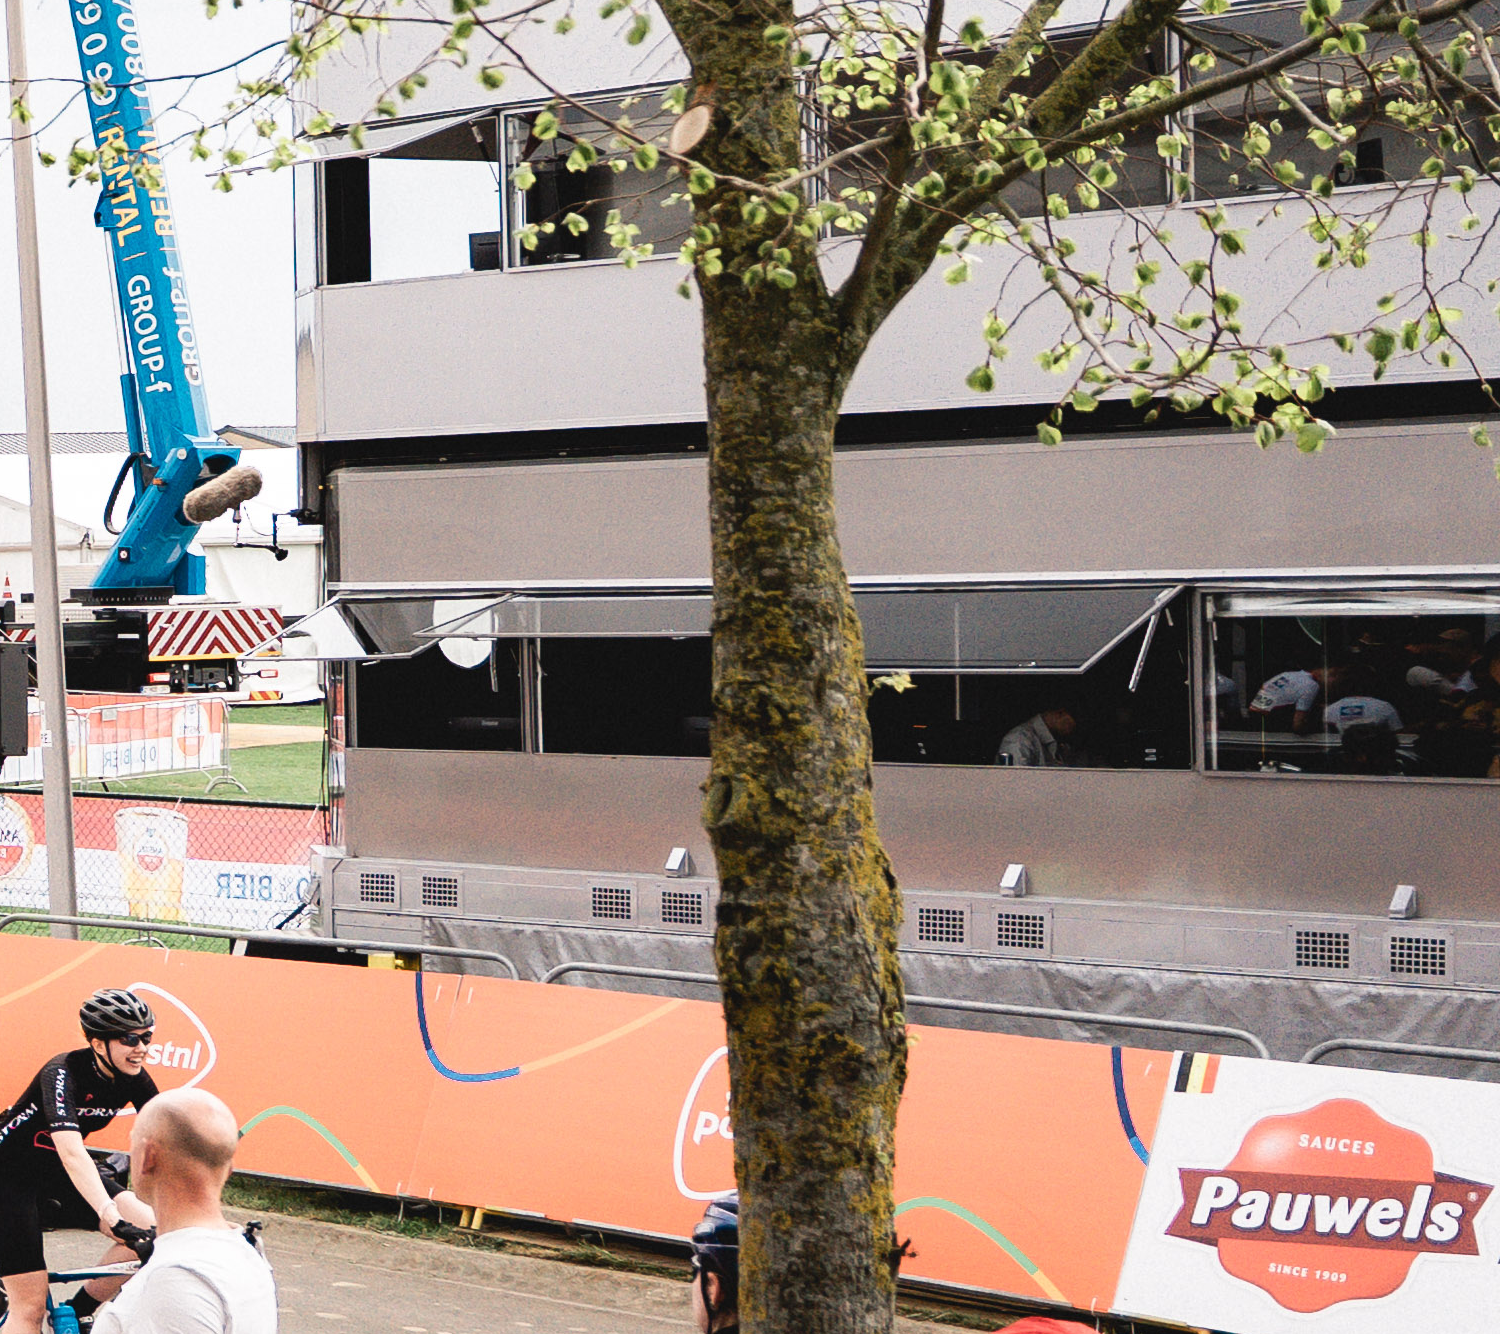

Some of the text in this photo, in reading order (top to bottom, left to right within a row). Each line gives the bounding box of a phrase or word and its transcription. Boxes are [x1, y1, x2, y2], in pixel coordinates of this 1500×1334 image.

[127, 274, 173, 394] GROUP-f
[145, 1040, 202, 1070] stnl
[55, 1067, 67, 1117] STORM
[1297, 1133, 1376, 1156] SAUCES
[1190, 1173, 1465, 1245] Pauwels
[1268, 1262, 1348, 1283] SINCE 1909
